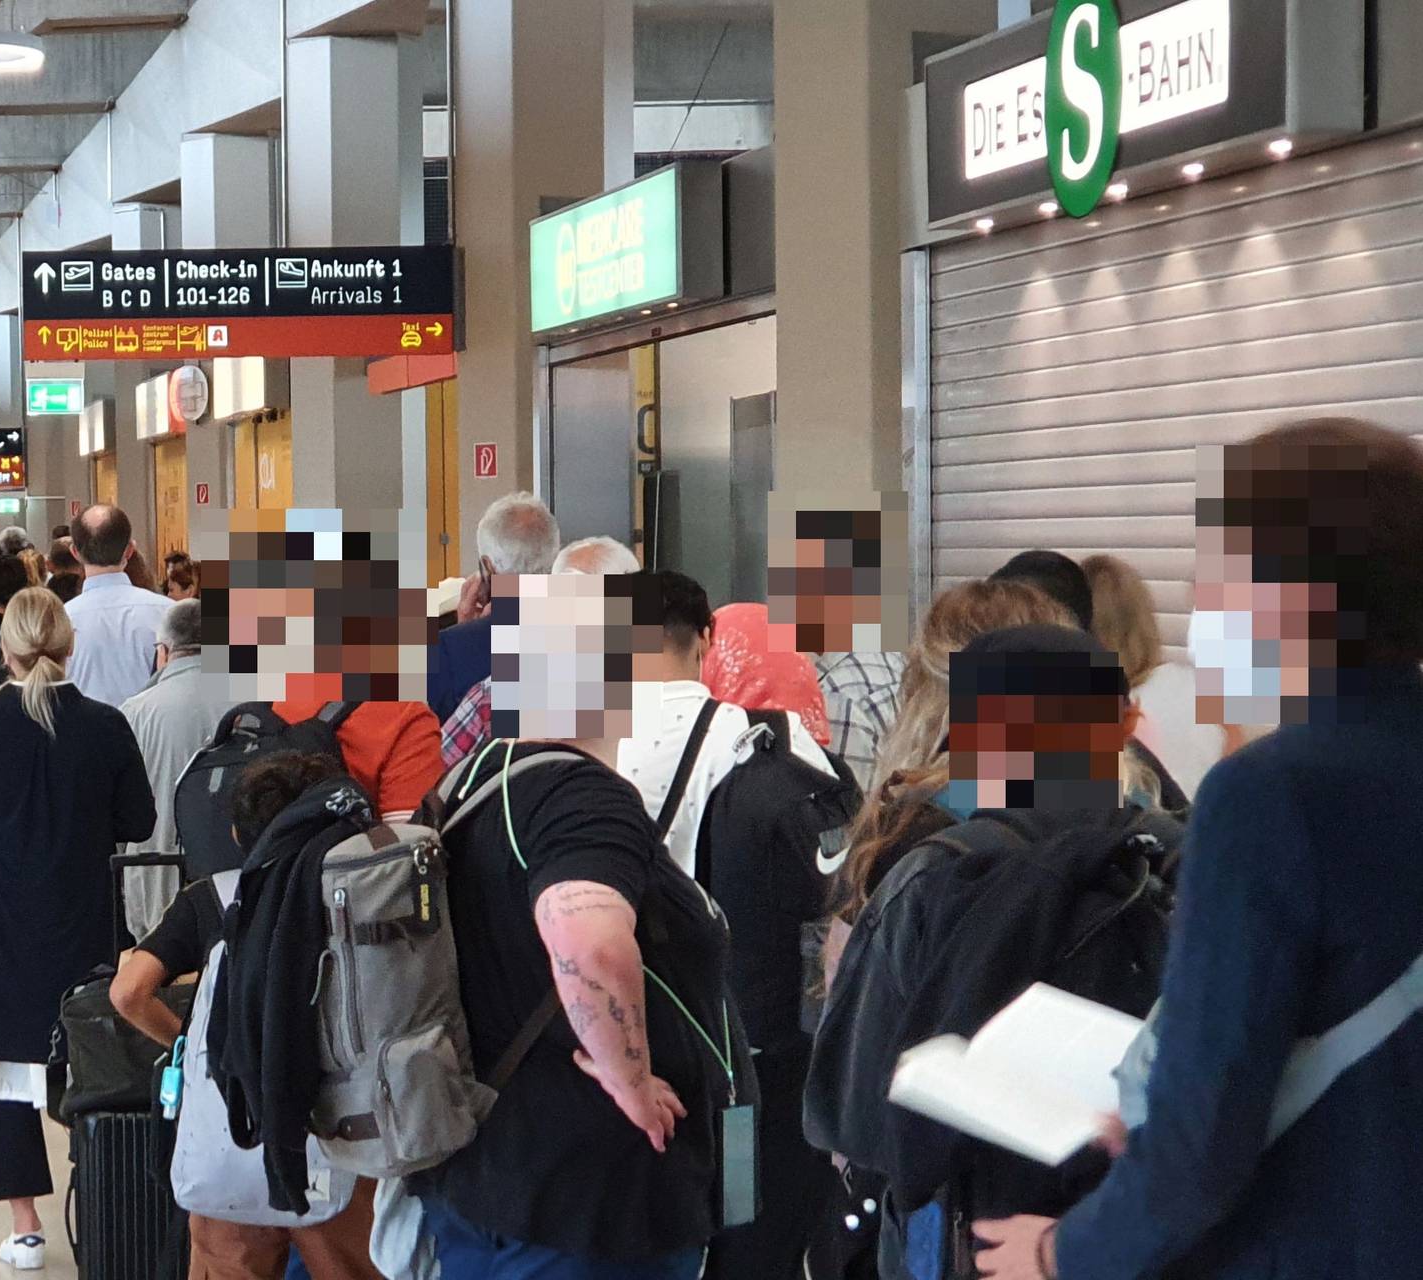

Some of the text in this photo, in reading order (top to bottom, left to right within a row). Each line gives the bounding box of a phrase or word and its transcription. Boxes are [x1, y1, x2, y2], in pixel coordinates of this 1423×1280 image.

[101, 258, 403, 281] Gates Check-in Ankunft 1
[102, 286, 403, 307] B C D 101-126 Arrivals 1
[402, 322, 420, 332] Taxi
[82, 328, 113, 338] Polizei
[82, 339, 109, 349] Police
